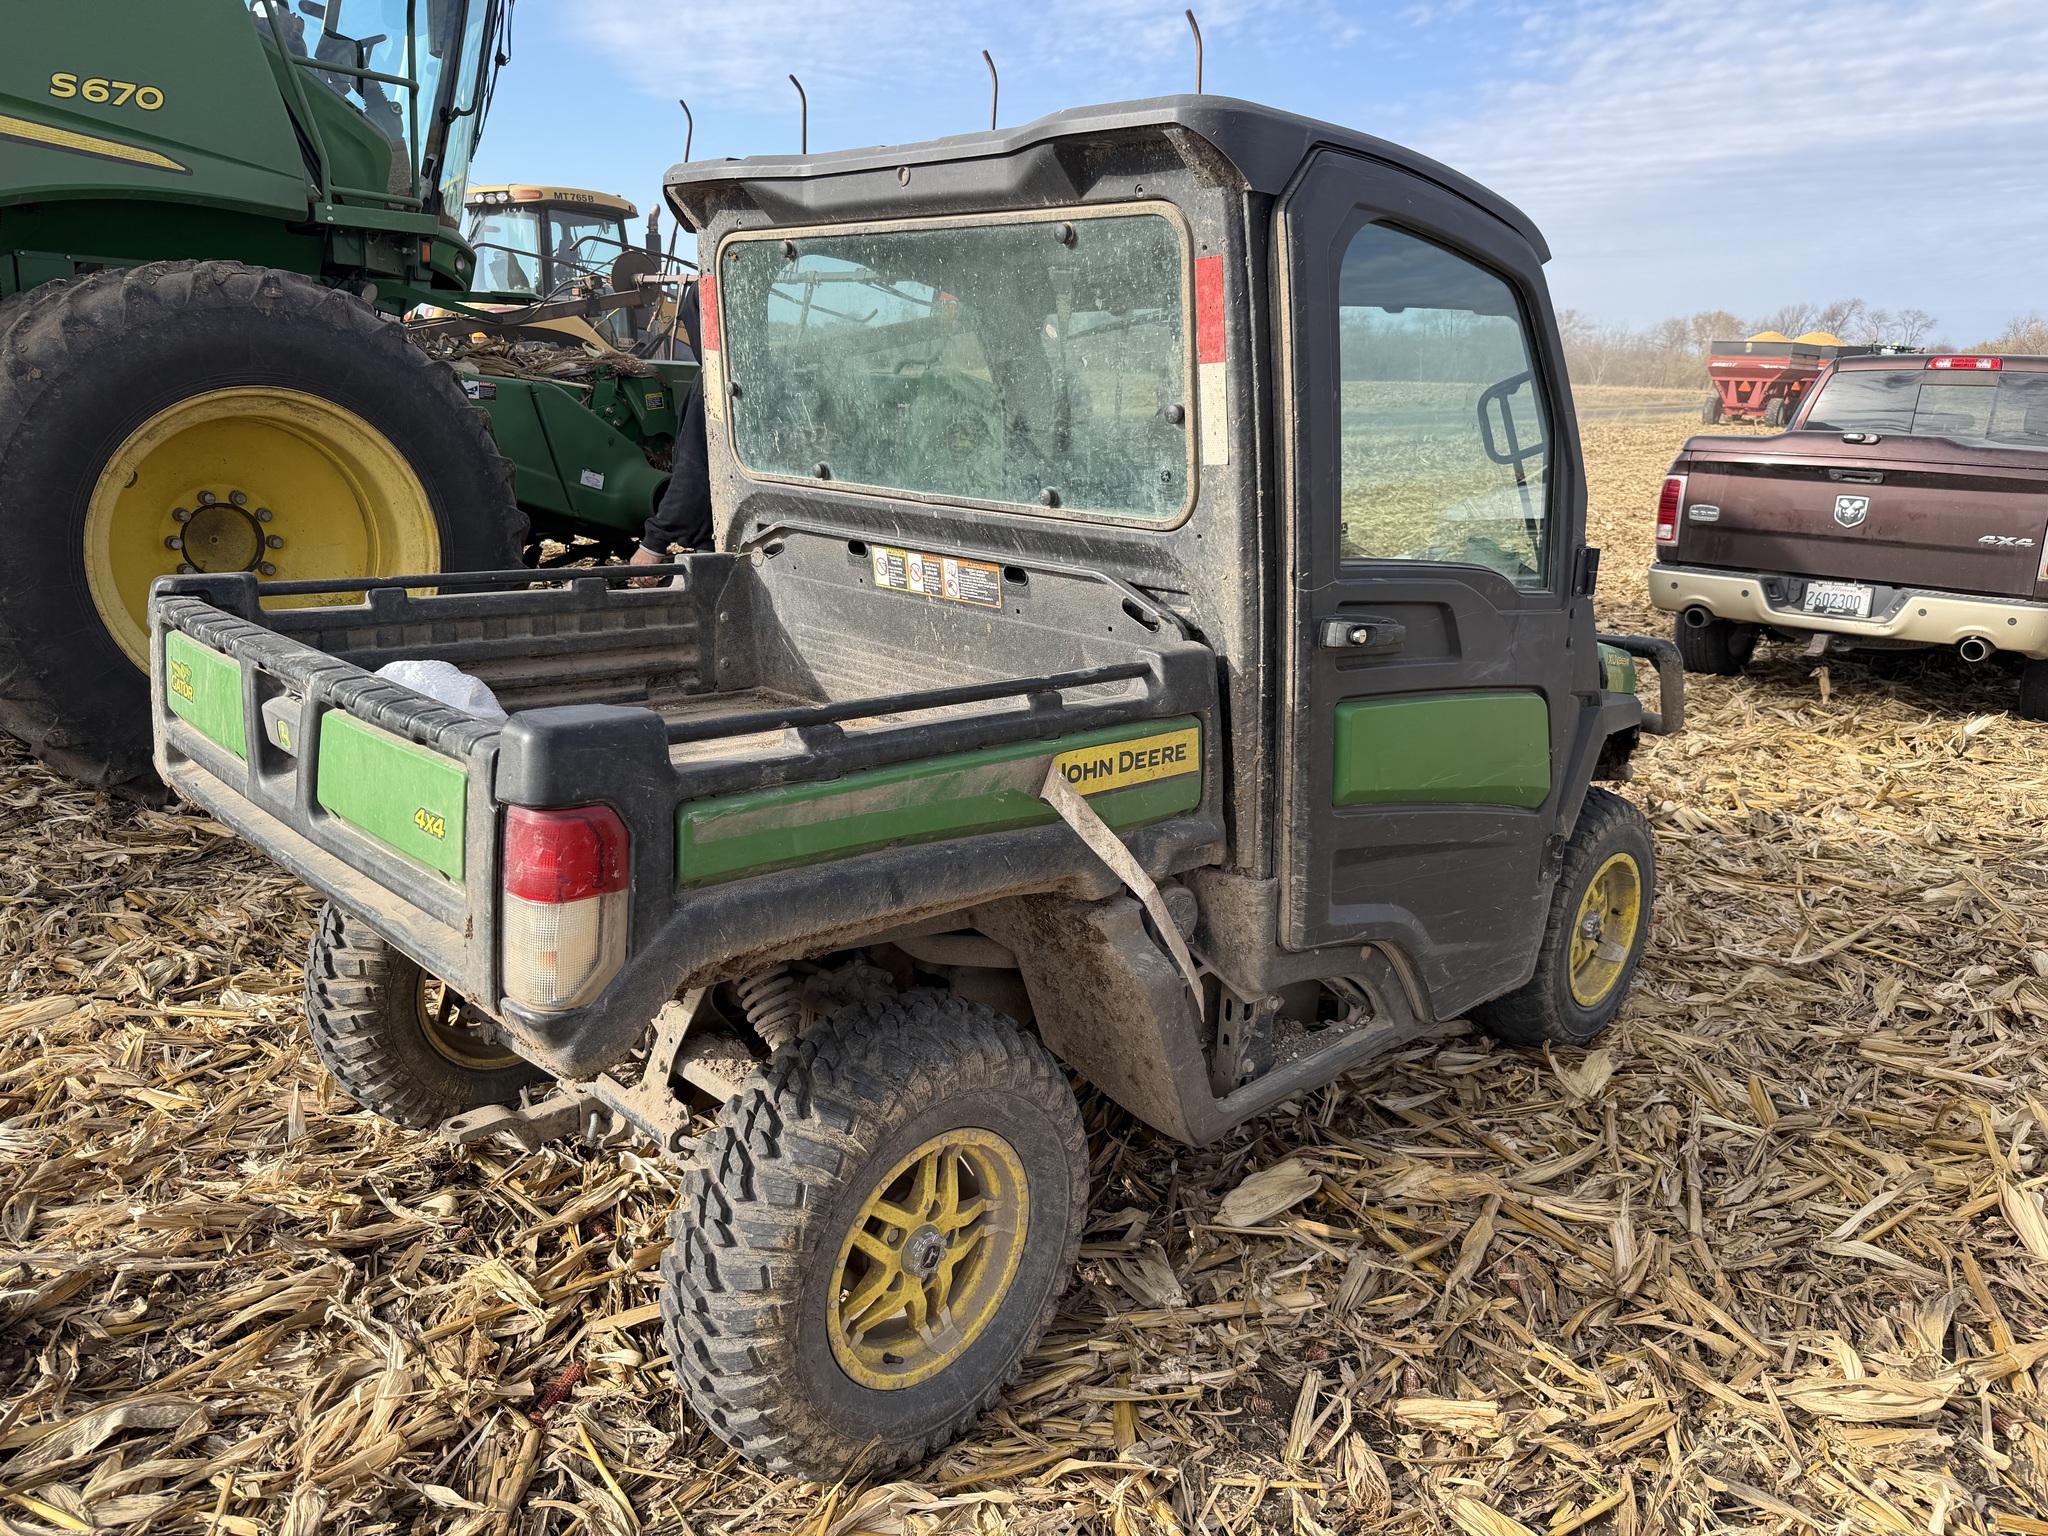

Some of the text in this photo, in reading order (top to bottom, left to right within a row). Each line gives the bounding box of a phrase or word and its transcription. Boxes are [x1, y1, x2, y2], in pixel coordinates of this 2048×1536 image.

[49, 72, 165, 111] S670
[1806, 590, 1862, 610] 2602300
[171, 674, 194, 704] GATOR
[1118, 743, 1187, 774] DEERE
